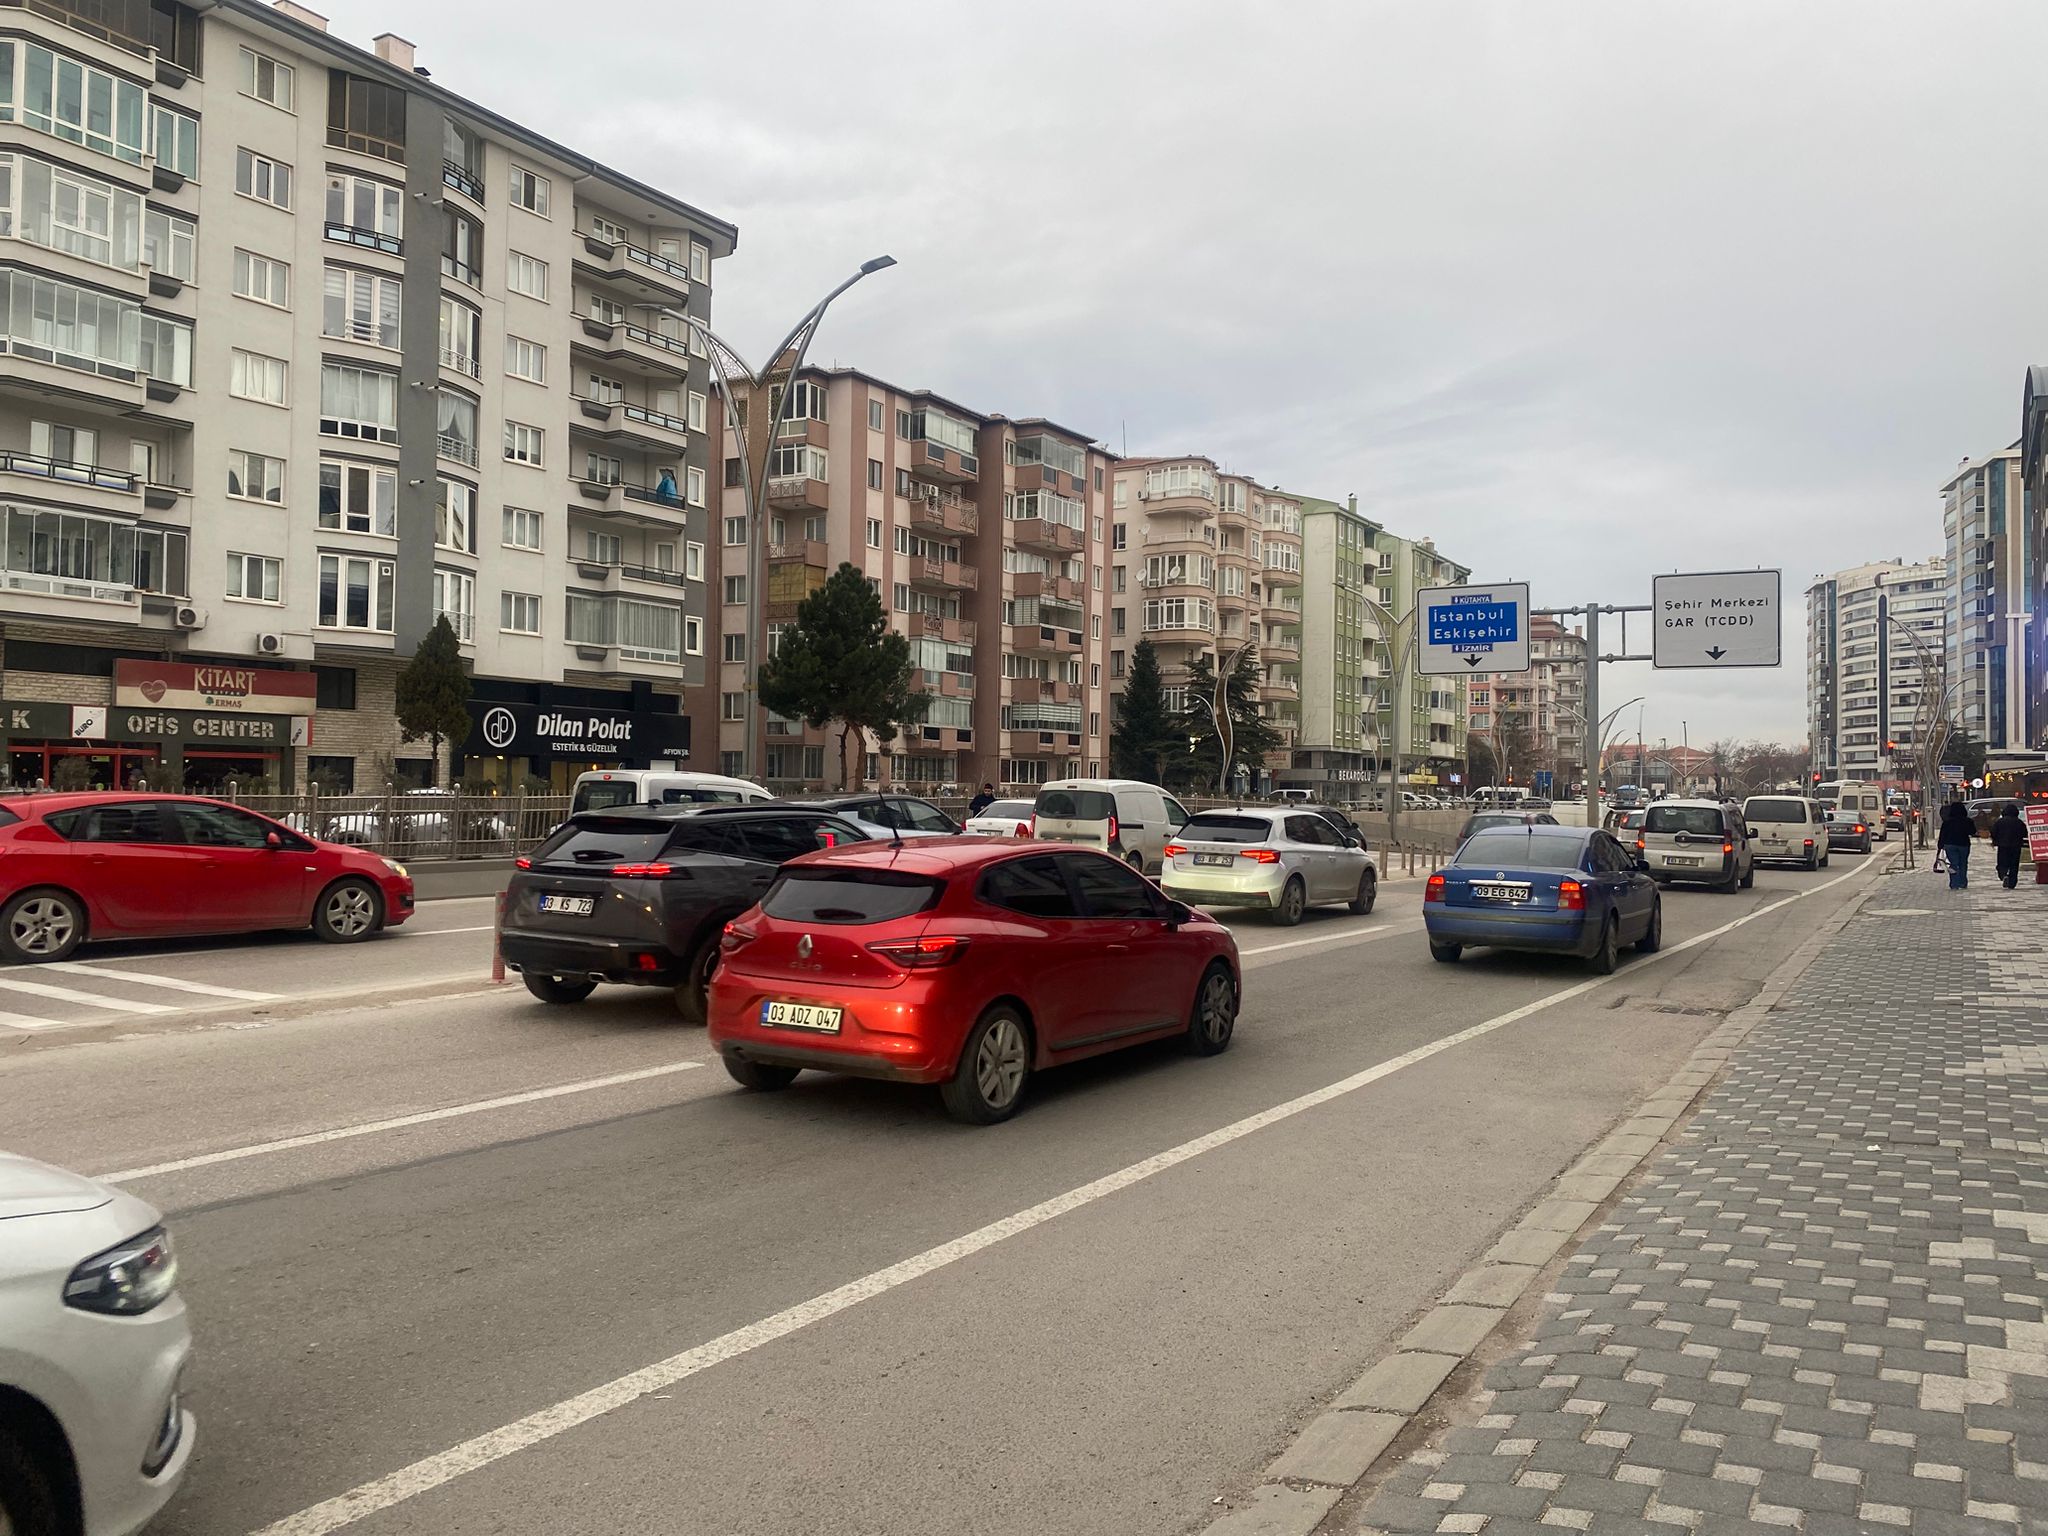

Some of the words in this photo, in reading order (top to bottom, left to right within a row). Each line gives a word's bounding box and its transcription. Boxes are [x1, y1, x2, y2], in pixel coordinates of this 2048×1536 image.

[1460, 596, 1490, 604] KÜTAHYA
[1665, 600, 1703, 611] Şehir
[1711, 597, 1768, 608] Merkezi
[1433, 608, 1503, 622] İstanbul
[1665, 618, 1694, 628] GAR
[1705, 614, 1753, 628] (TCDD)
[1434, 626, 1511, 639] Eskişehir
[1461, 644, 1490, 652] İZMİR
[215, 699, 242, 709] ERMAŞ
[11, 709, 31, 729] K
[127, 712, 179, 735] OFİS
[193, 718, 274, 738] CENTER
[536, 713, 583, 737] Dilan
[588, 717, 632, 740] Polat
[552, 742, 579, 752] ESTETİK
[579, 744, 586, 752] &
[586, 743, 617, 753] GÜZELLİK
[1476, 886, 1488, 896] 09
[1491, 887, 1506, 897] EG
[1508, 889, 1527, 899] 642
[560, 898, 571, 910] KS
[577, 899, 592, 912] 723
[770, 1006, 785, 1022] 03
[790, 1007, 810, 1025] ADZ
[816, 1010, 838, 1028] 047
